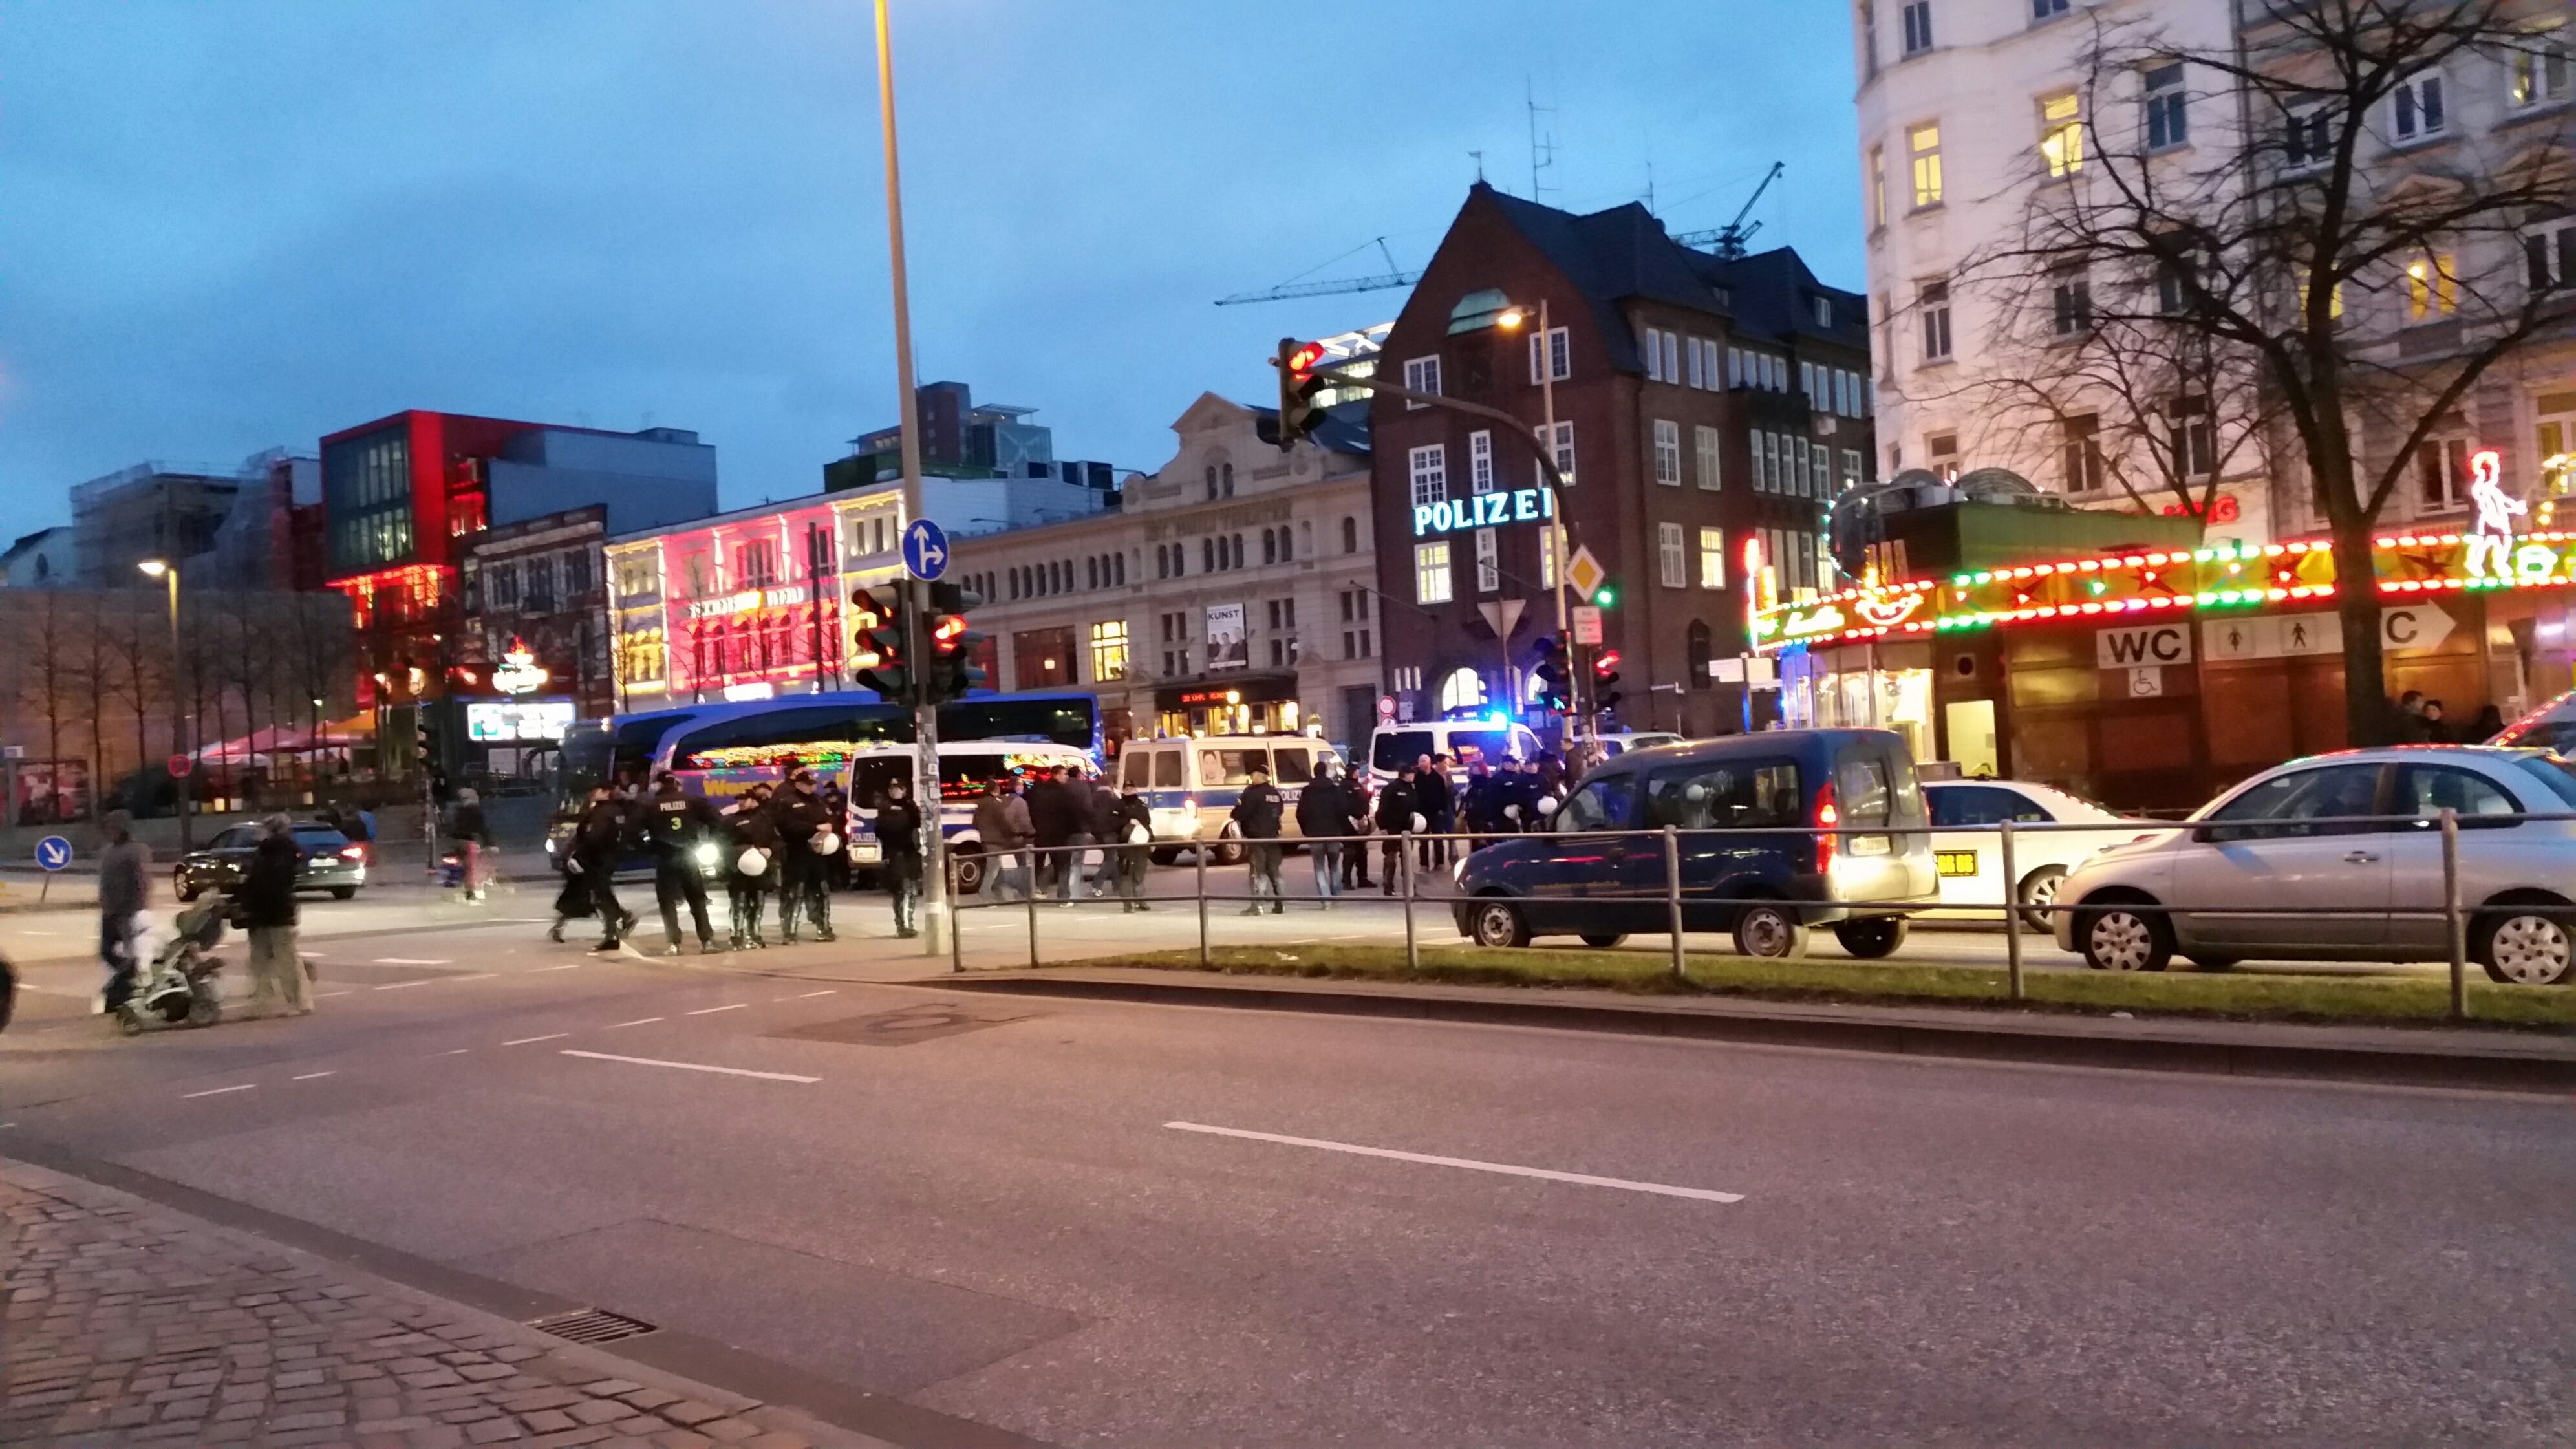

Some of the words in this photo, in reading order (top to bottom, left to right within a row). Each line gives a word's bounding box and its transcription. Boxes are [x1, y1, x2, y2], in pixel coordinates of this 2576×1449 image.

[1414, 487, 1553, 536] POLIZEI
[1208, 609, 1240, 621] KUNST
[2386, 611, 2418, 644] C
[2107, 628, 2182, 663] WC
[660, 800, 686, 812] POLIZEI
[671, 816, 682, 831] 3
[851, 832, 876, 843] POLIZEI
